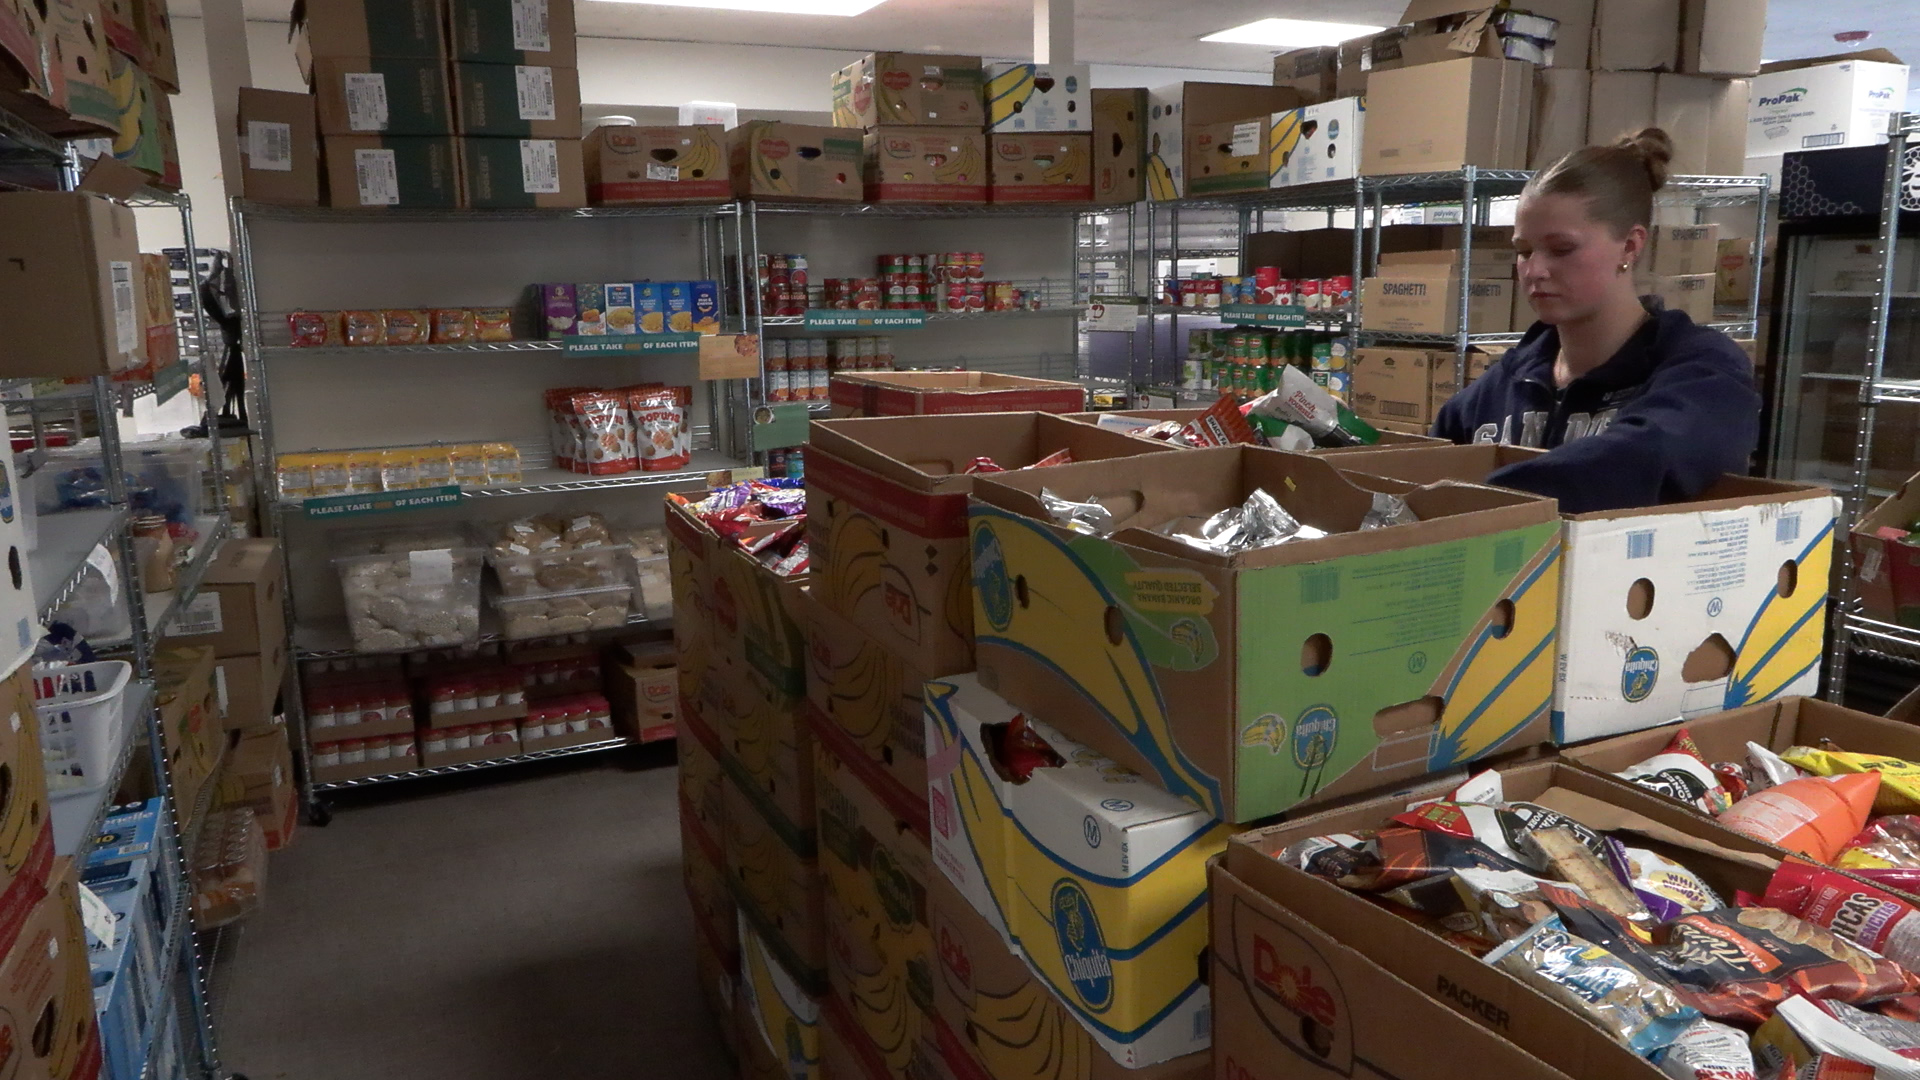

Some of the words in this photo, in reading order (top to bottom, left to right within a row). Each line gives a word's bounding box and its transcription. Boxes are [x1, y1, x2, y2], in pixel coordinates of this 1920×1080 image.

[1758, 93, 1800, 107] ProPak
[1868, 90, 1890, 99] ProPak
[1382, 282, 1426, 296] SPAGHETTI
[809, 318, 836, 326] PLEASE
[905, 317, 922, 325] ITEM
[569, 343, 598, 351] PLEASE
[601, 342, 623, 350] TAKE
[655, 341, 678, 349] EACH
[679, 340, 698, 348] ITEM
[1288, 396, 1315, 420] YOURSELF
[1294, 390, 1316, 412] Pinch
[1205, 417, 1224, 437] SNACK
[310, 505, 344, 515] PLEASE
[347, 502, 372, 511] TAKE
[408, 497, 434, 505] EACH
[435, 494, 457, 502] ITEM
[1133, 580, 1163, 592] QUALITY
[1163, 581, 1202, 593] SELECTED
[1136, 592, 1166, 604] BANANA
[1167, 593, 1202, 605] ORGANIC
[1625, 656, 1658, 674] Chiquita
[1294, 715, 1337, 736] Chiquita
[1675, 923, 1748, 970] Thins
[1064, 950, 1112, 988] Chiquita
[1254, 934, 1337, 1027] Dole
[1436, 974, 1511, 1031] PACKER
